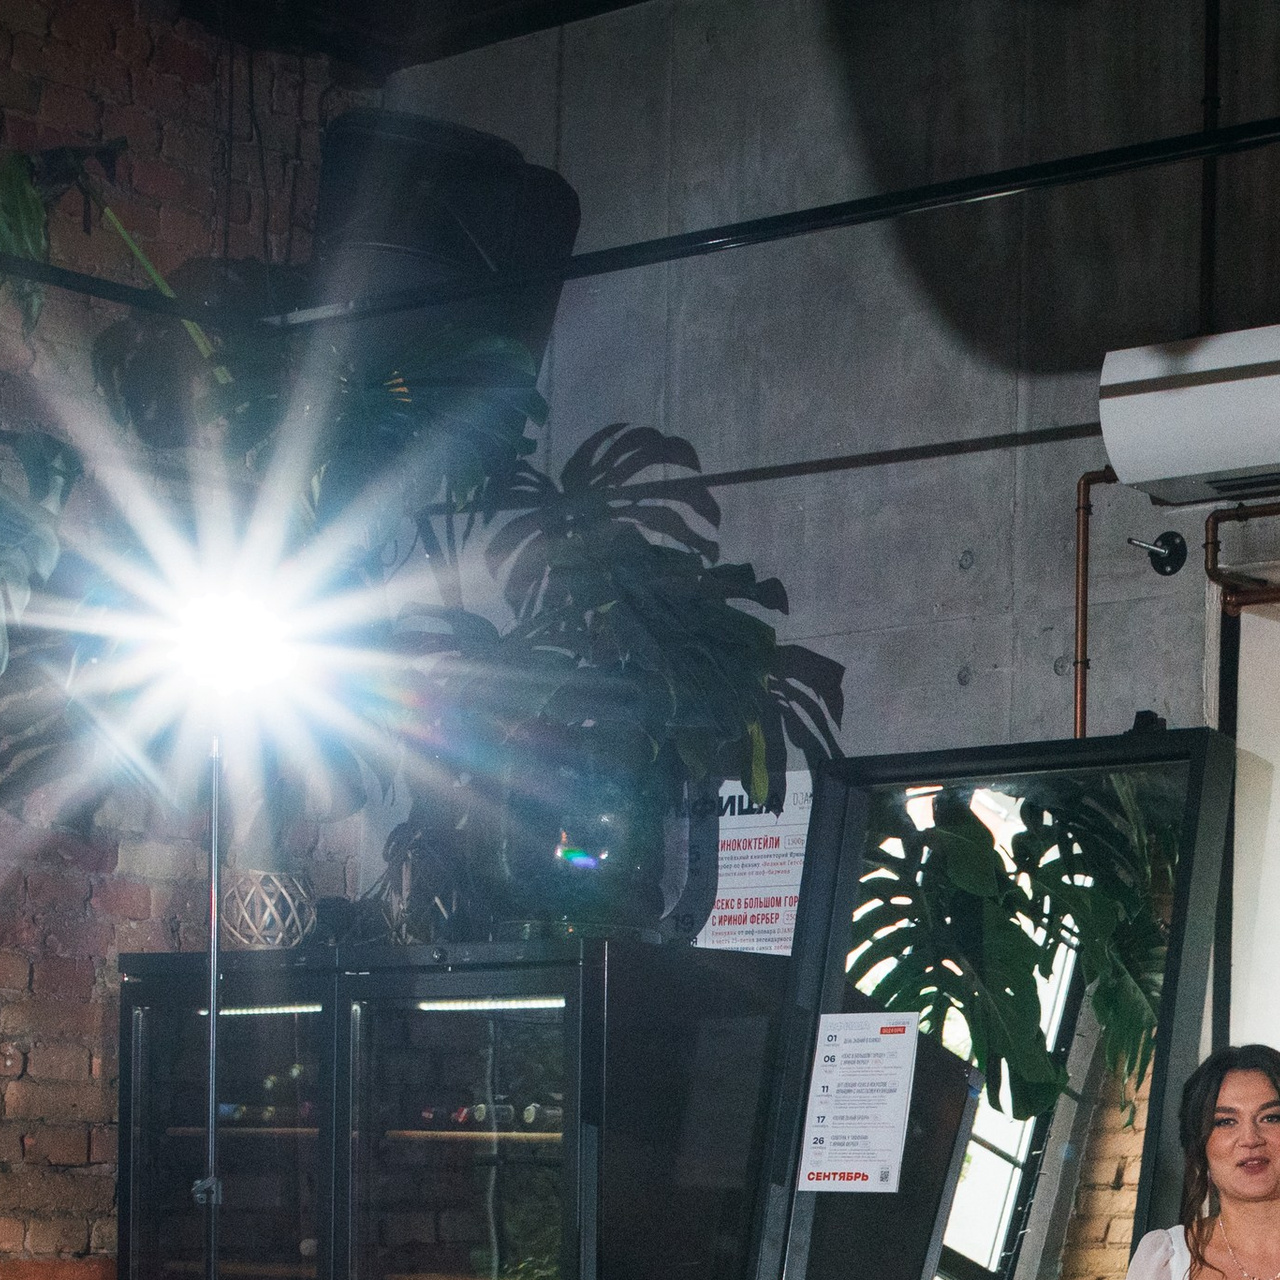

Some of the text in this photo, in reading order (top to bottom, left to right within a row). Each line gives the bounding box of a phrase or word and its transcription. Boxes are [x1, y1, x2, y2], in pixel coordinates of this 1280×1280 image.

[719, 835, 780, 852] ИНОКОКТЕЙЛИ
[737, 898, 743, 909] В
[744, 896, 782, 909] БОЛЬШОМ
[784, 896, 799, 907] ГОР
[712, 915, 716, 926] С
[718, 912, 748, 925] ИРИНОЙ
[750, 913, 780, 925] ФЕРБЕР
[827, 1034, 838, 1043] 01
[823, 1055, 836, 1063] 06
[821, 1085, 829, 1093] 11
[816, 1115, 826, 1124] 17
[813, 1137, 824, 1145] 26
[807, 1171, 869, 1182] СЕНТЯБРЬ
